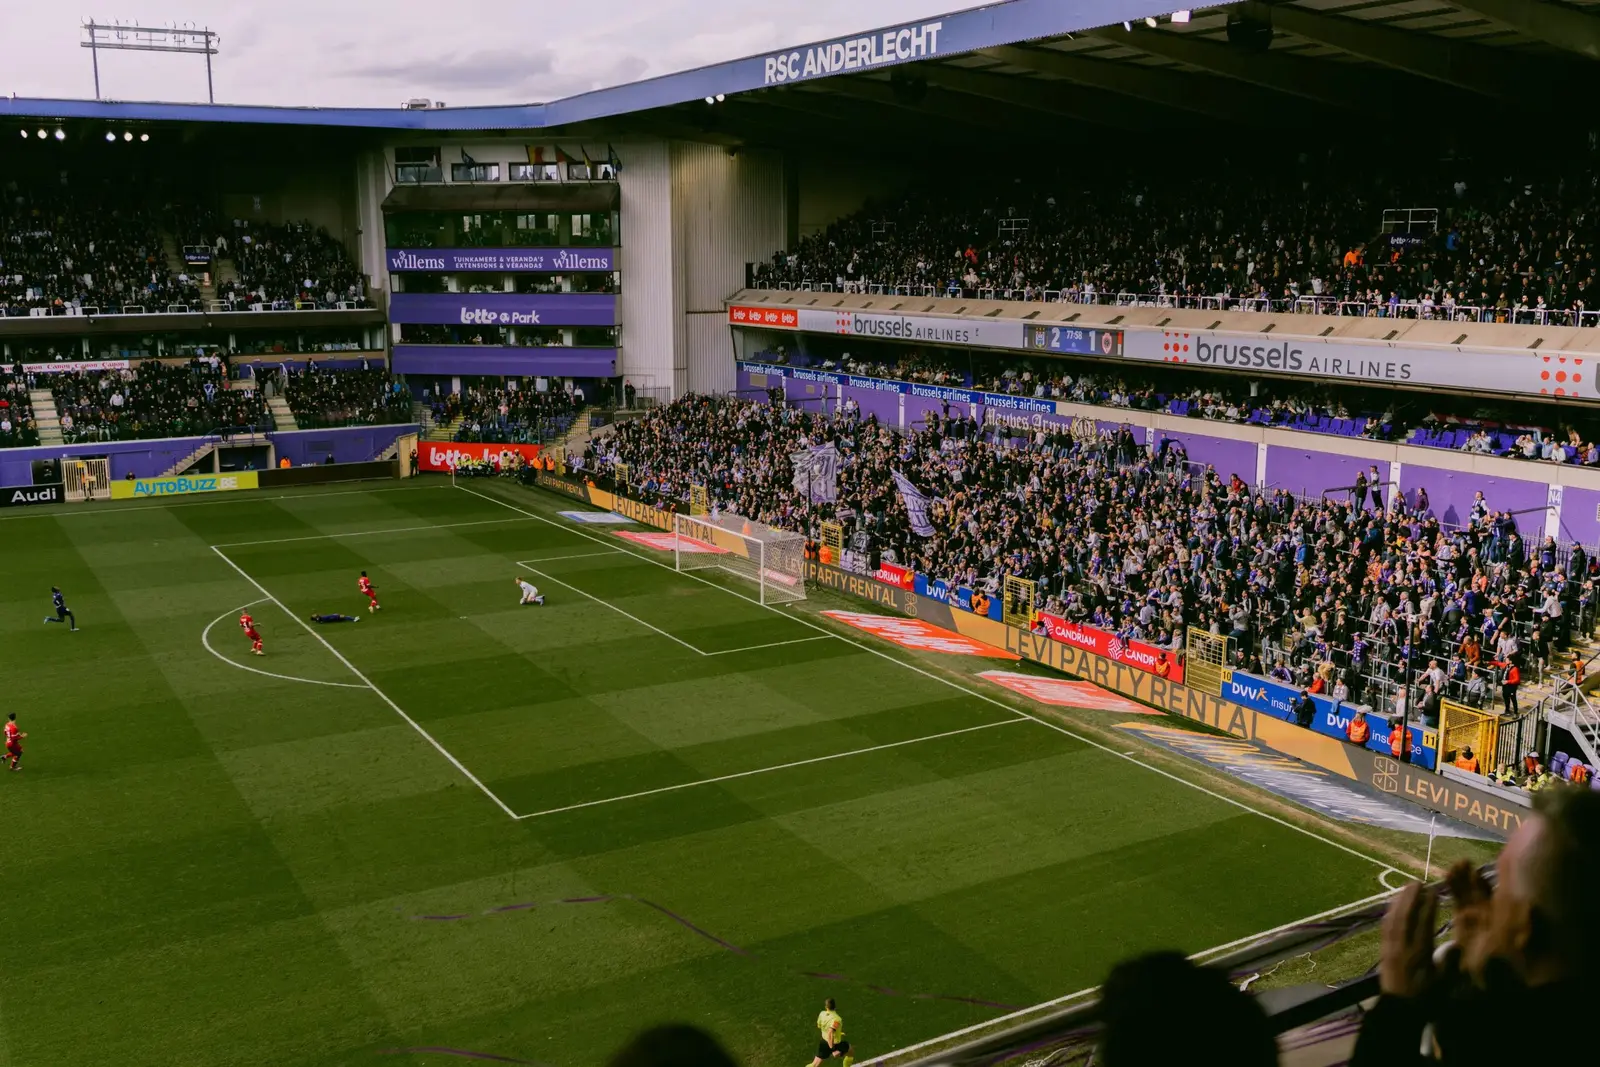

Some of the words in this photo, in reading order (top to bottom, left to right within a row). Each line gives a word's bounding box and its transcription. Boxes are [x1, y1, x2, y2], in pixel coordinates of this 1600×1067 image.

[765, 51, 801, 84] RSC
[802, 22, 942, 77] ANDERLECHT
[392, 252, 445, 269] willems
[553, 252, 608, 269] willems
[512, 310, 540, 324] Park
[854, 314, 912, 338] brussels
[916, 327, 969, 342] AIRLINES
[1051, 327, 1060, 348] 2
[1066, 330, 1083, 340] 77:58
[1089, 330, 1096, 352] 1
[1196, 336, 1302, 370] brussels
[1309, 356, 1412, 380] AIRLINES
[743, 362, 764, 374] brussels
[764, 366, 784, 376] airlines
[794, 368, 816, 381] brussels
[817, 373, 838, 384] airlines
[850, 376, 874, 390] brussels
[876, 381, 900, 393] airlines
[912, 384, 942, 399] brussels
[942, 389, 970, 403] airlines
[984, 393, 1018, 410] brussels
[1018, 398, 1051, 413] airlines
[11, 488, 57, 502] Audi
[612, 494, 634, 514] LEVI
[635, 504, 670, 531] PARTY
[810, 564, 850, 590] PARTY
[850, 578, 898, 608] RENTAL
[874, 570, 900, 584] NDRIAM
[1056, 626, 1096, 648] CANDRIAM
[1124, 648, 1157, 666] CANDR
[1006, 626, 1052, 666] LEVI
[1060, 647, 1150, 698] PARTY
[1150, 675, 1258, 741] RENTAL
[1222, 671, 1232, 681] 10
[1232, 682, 1257, 700] DVV
[1424, 733, 1435, 746] 11
[1405, 775, 1449, 807] LEVI
